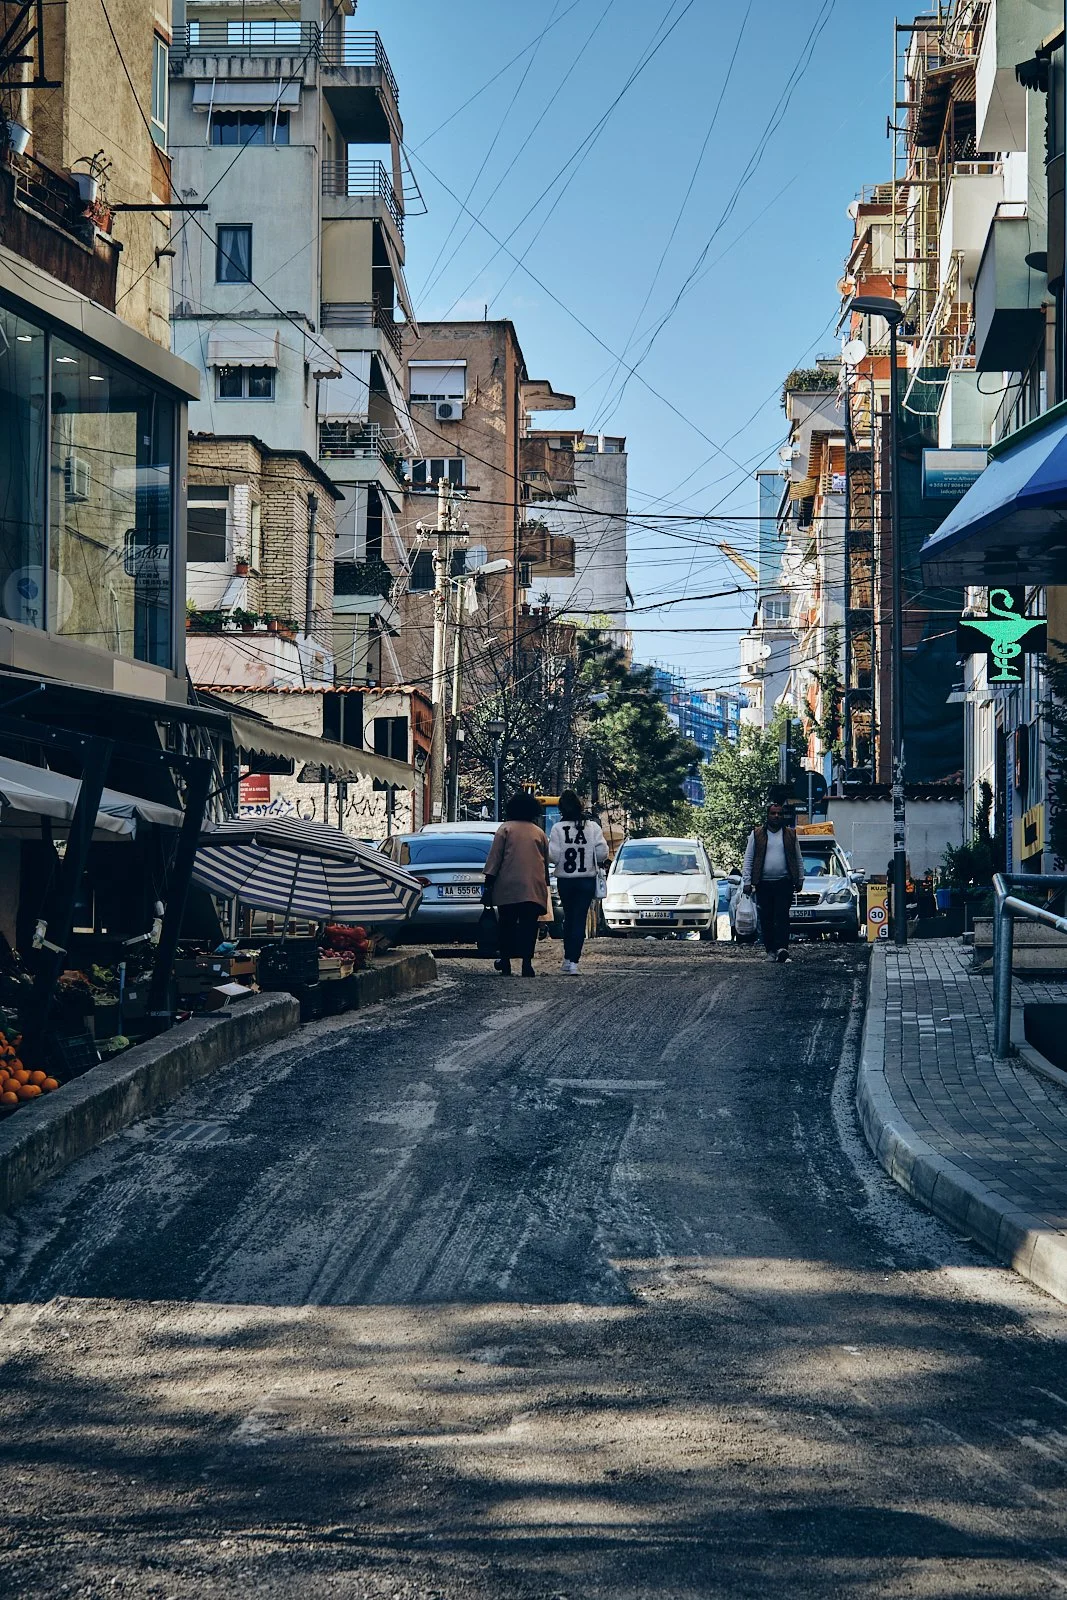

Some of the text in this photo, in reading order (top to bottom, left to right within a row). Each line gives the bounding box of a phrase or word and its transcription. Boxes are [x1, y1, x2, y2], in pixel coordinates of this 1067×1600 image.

[562, 826, 587, 844] LA
[564, 847, 587, 873] 81
[445, 886, 454, 895] AA
[871, 911, 884, 919] 30
[880, 928, 887, 936] 5
